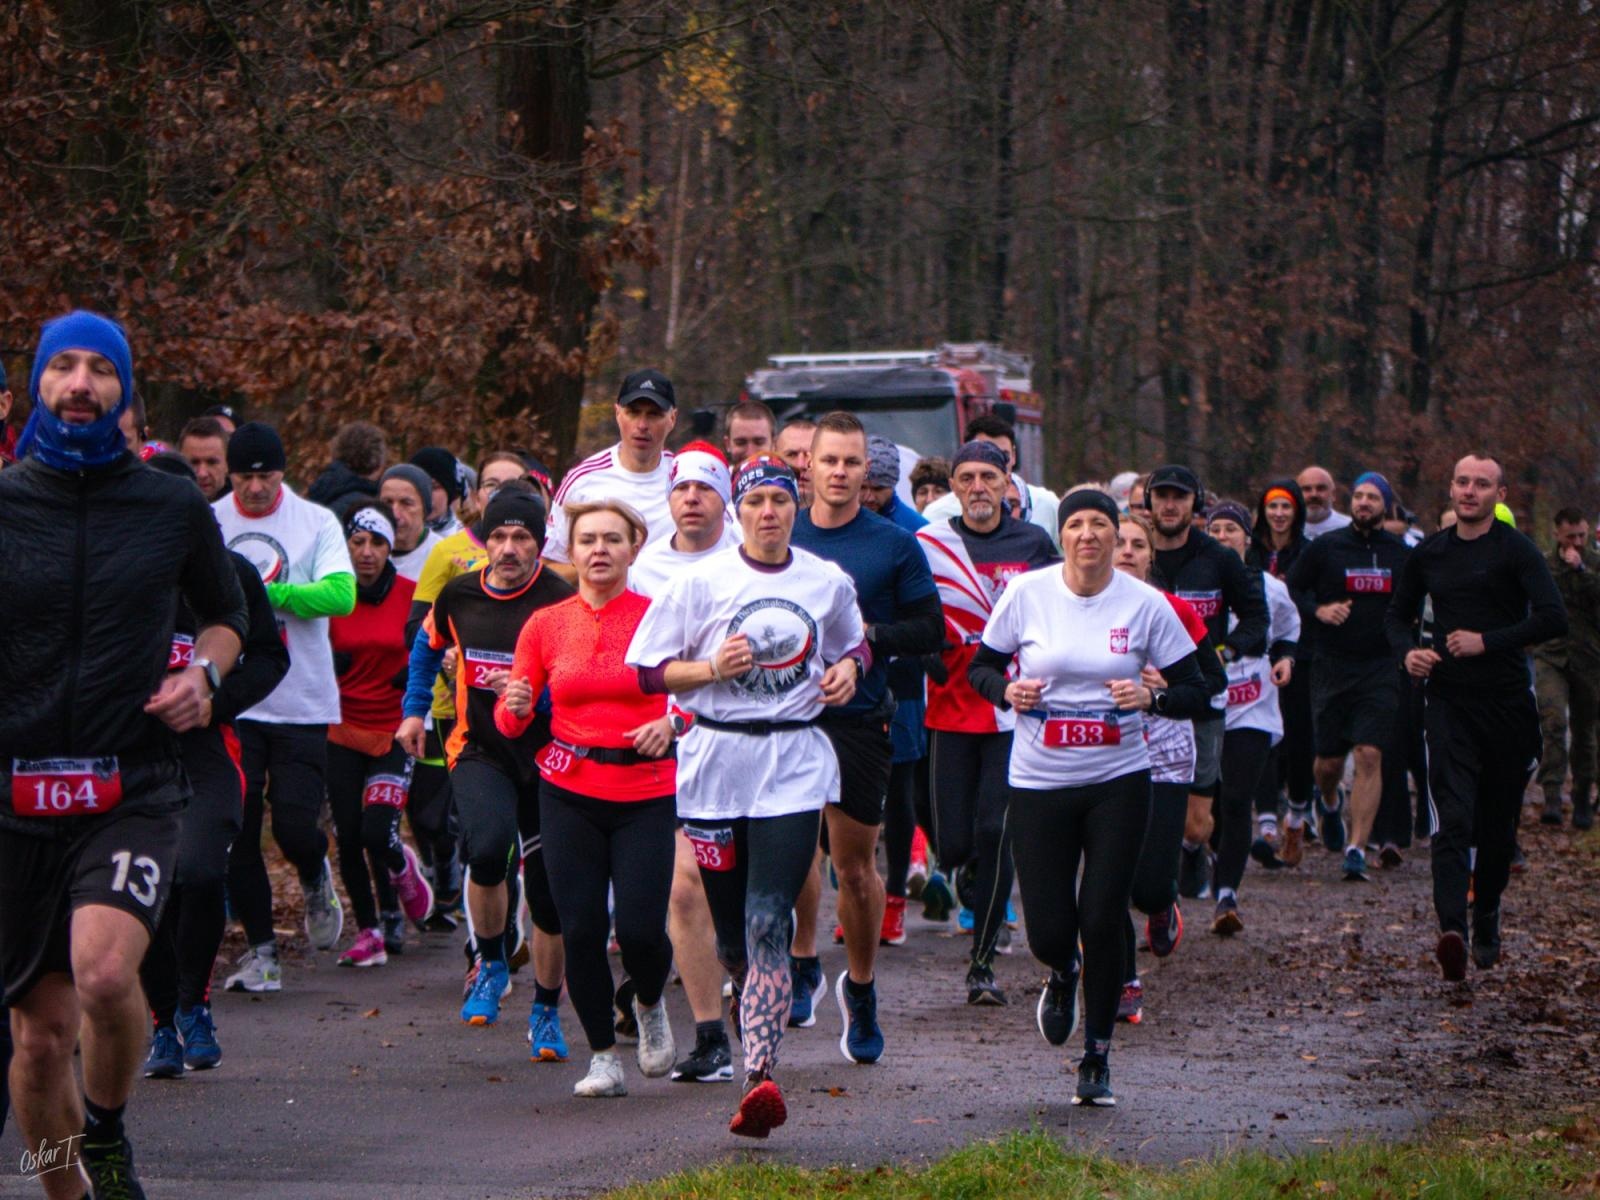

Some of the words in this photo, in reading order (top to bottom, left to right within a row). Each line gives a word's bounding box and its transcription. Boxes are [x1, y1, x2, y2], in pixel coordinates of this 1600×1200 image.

[1354, 577, 1384, 591] 079
[1059, 723, 1104, 745] 133
[544, 746, 572, 773] 231
[34, 779, 98, 810] 164
[367, 786, 402, 805] 245
[694, 843, 722, 867] 53
[111, 850, 160, 907] 13
